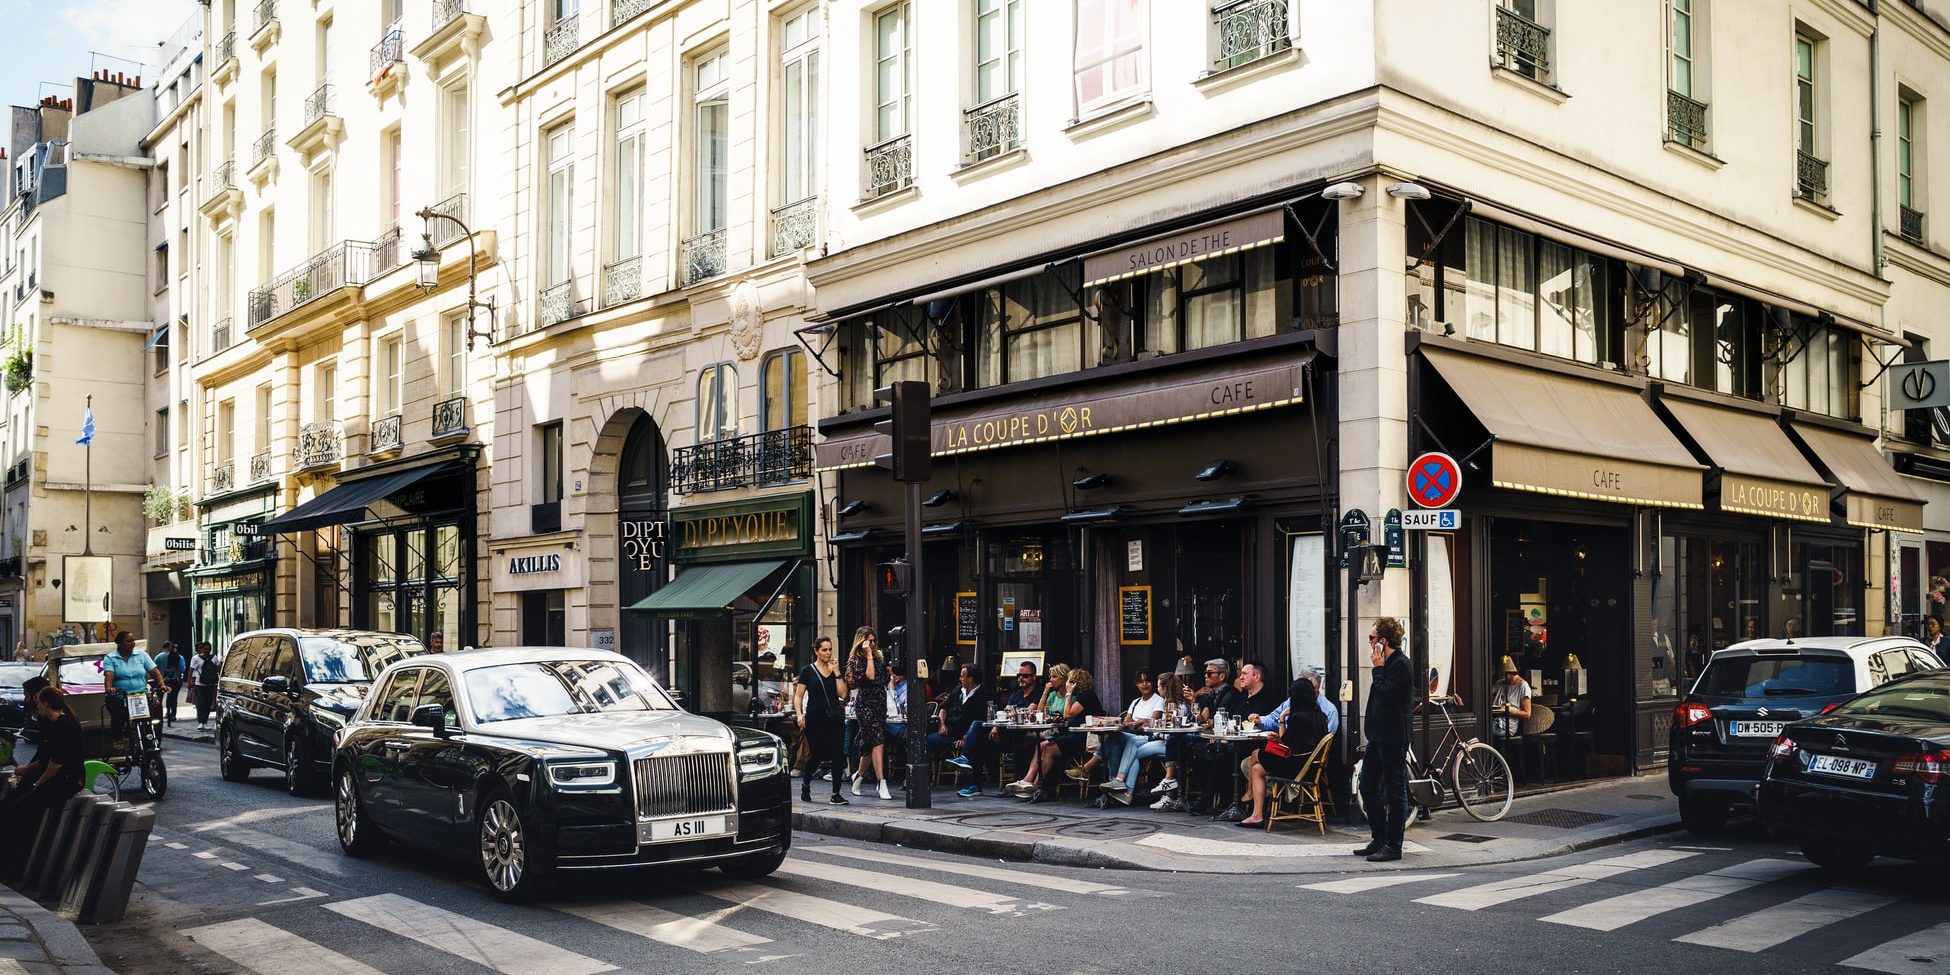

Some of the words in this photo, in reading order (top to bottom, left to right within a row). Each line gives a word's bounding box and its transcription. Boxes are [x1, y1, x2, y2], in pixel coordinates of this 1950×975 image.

[1129, 244, 1175, 270] SALON
[1180, 239, 1198, 257] DE
[1202, 231, 1230, 251] THE
[1211, 381, 1254, 405] CAFE
[948, 427, 968, 448] LA
[973, 416, 1031, 443] COUPE
[840, 443, 866, 460] CAFE
[1593, 470, 1621, 490] CAFE
[1731, 483, 1746, 505] LA
[1749, 486, 1786, 510] COUPE
[1404, 514, 1437, 525] SAUF
[1878, 506, 1894, 522] CAFE
[622, 521, 665, 538] DIPT
[684, 511, 789, 548] DIPTYQUE
[166, 538, 195, 549] Obilis
[508, 553, 561, 575] AKILLIS
[599, 636, 615, 645] 332
[1815, 757, 1867, 775] EL-098-NP
[674, 822, 691, 836] AS
